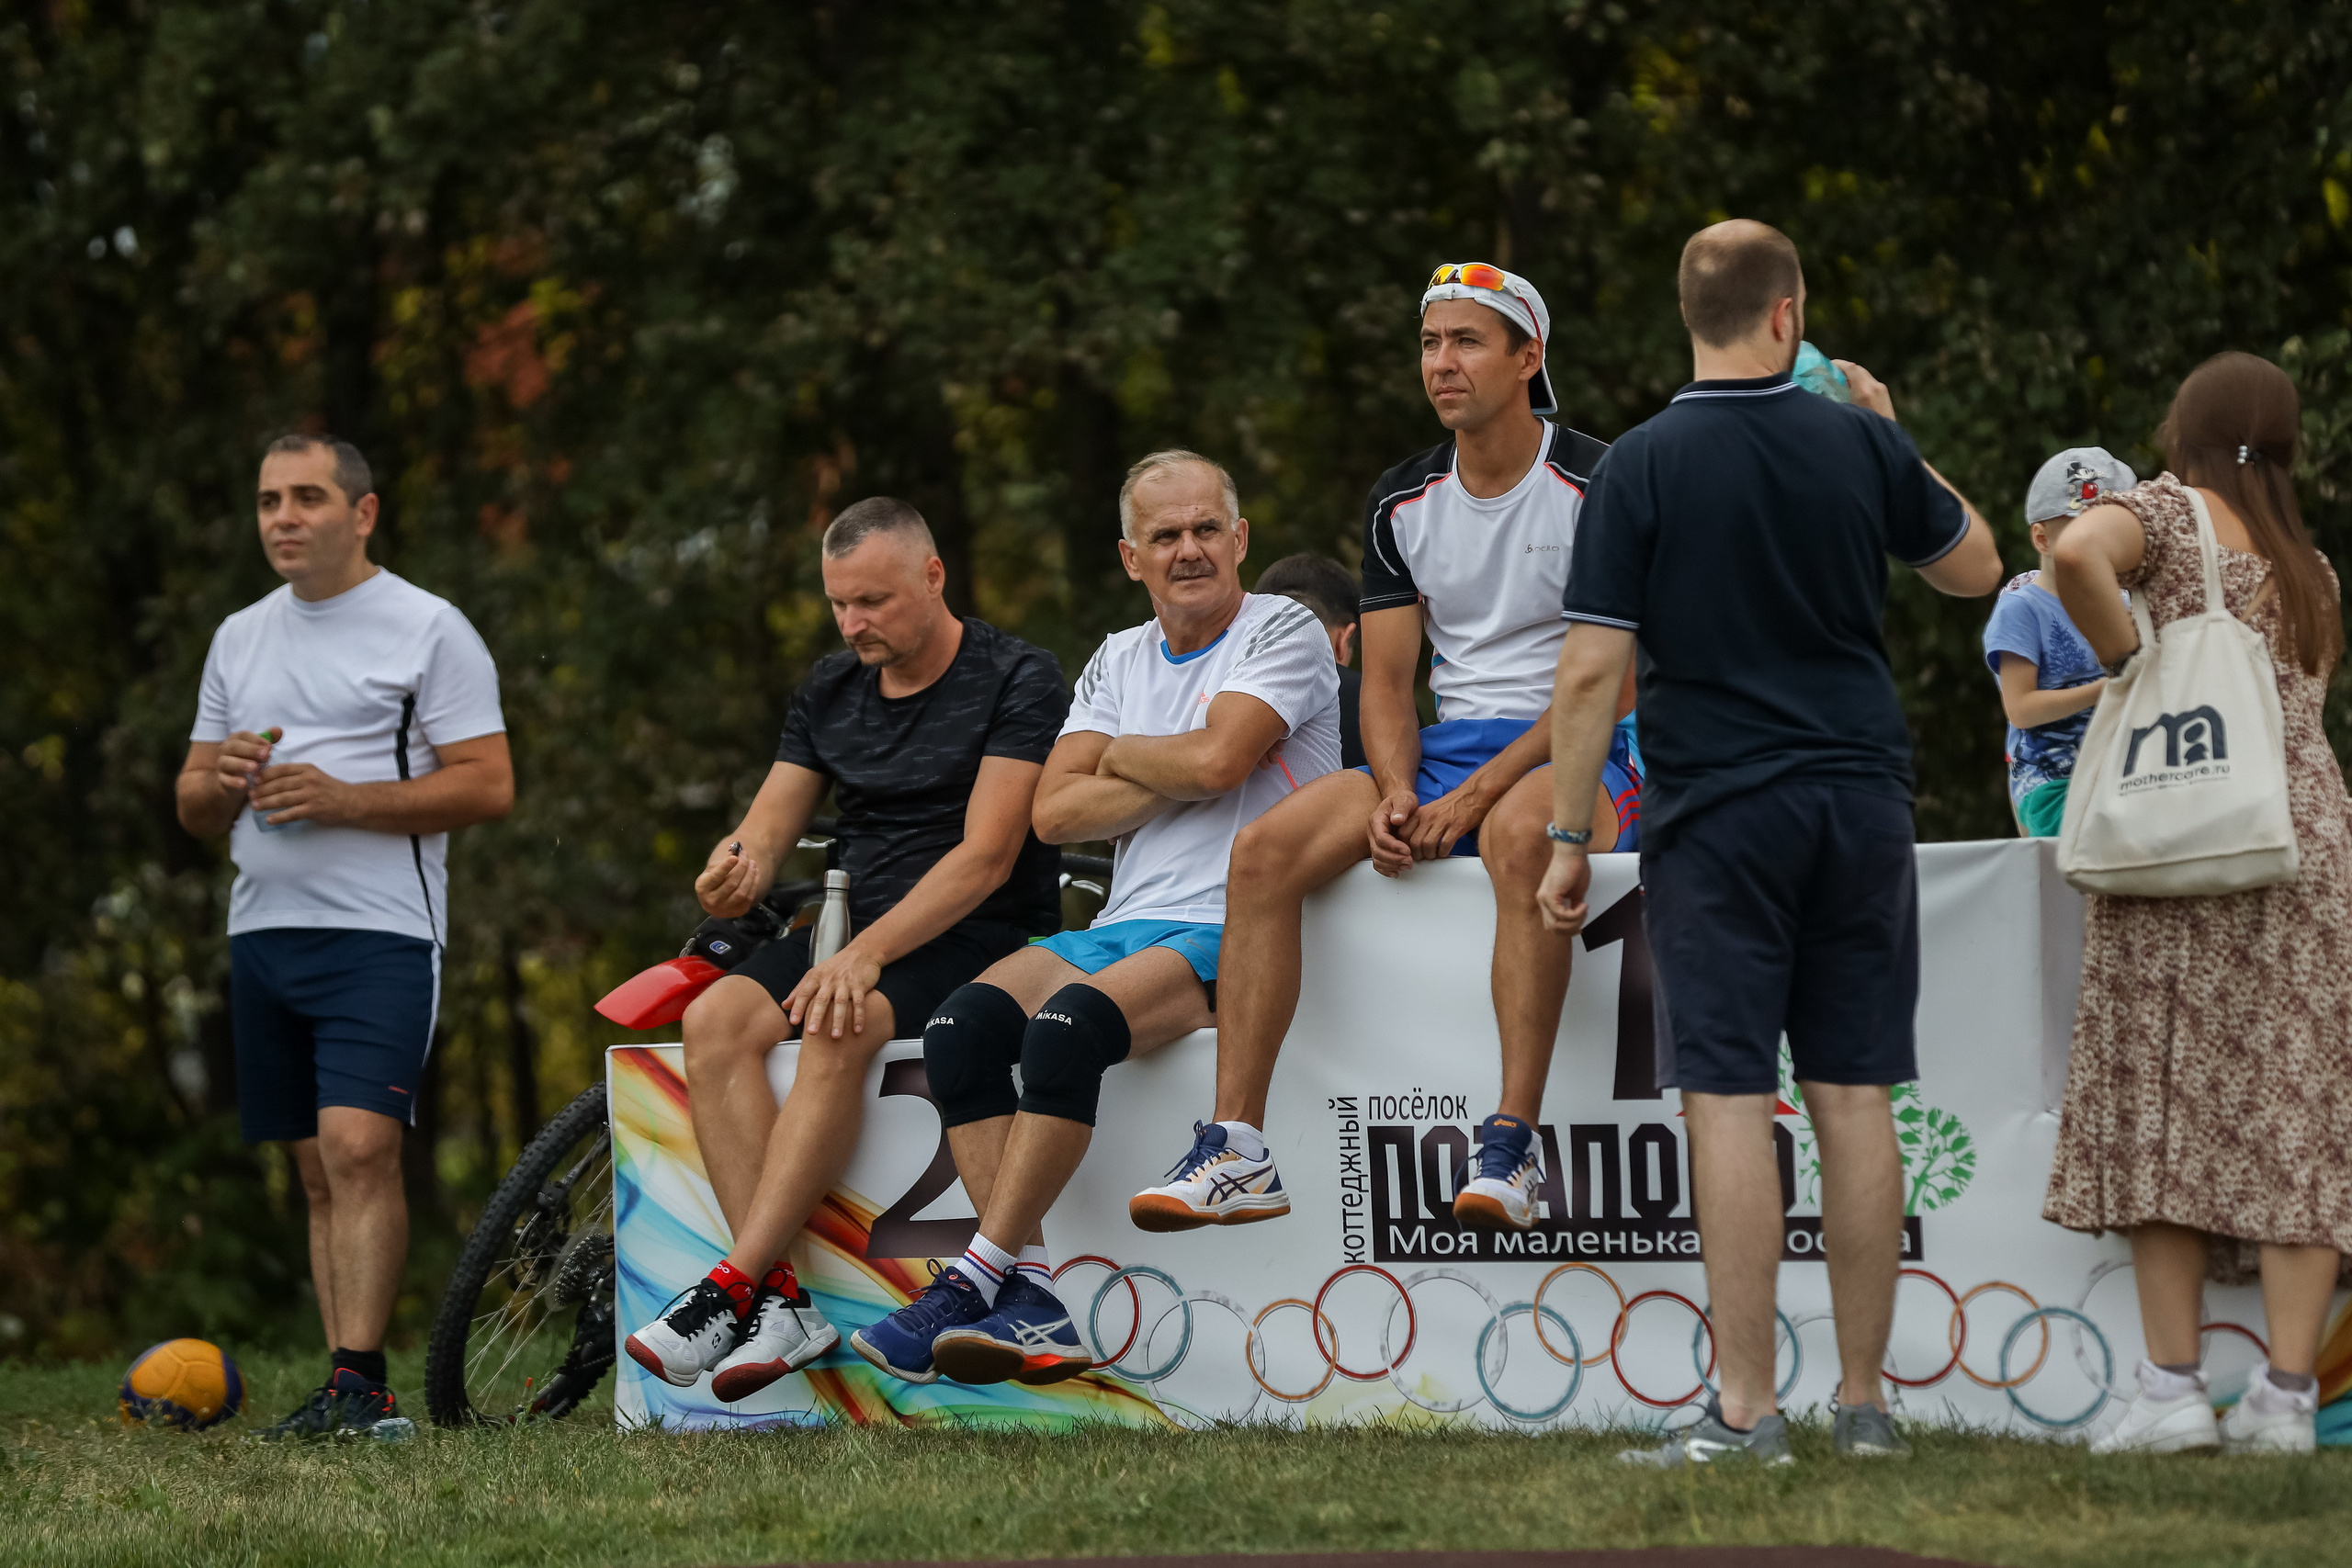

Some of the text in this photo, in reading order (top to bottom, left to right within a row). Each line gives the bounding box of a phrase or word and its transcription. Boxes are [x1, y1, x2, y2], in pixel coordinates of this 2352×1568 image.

[2120, 764, 2231, 790] mothercare.ru
[1580, 883, 1664, 1100] 1
[1368, 1087, 1468, 1121] посёлок
[865, 1057, 979, 1258] 2
[1329, 1096, 1369, 1264] коттеджный
[1388, 1224, 1478, 1255] Моя
[1493, 1229, 1702, 1255] маленька
